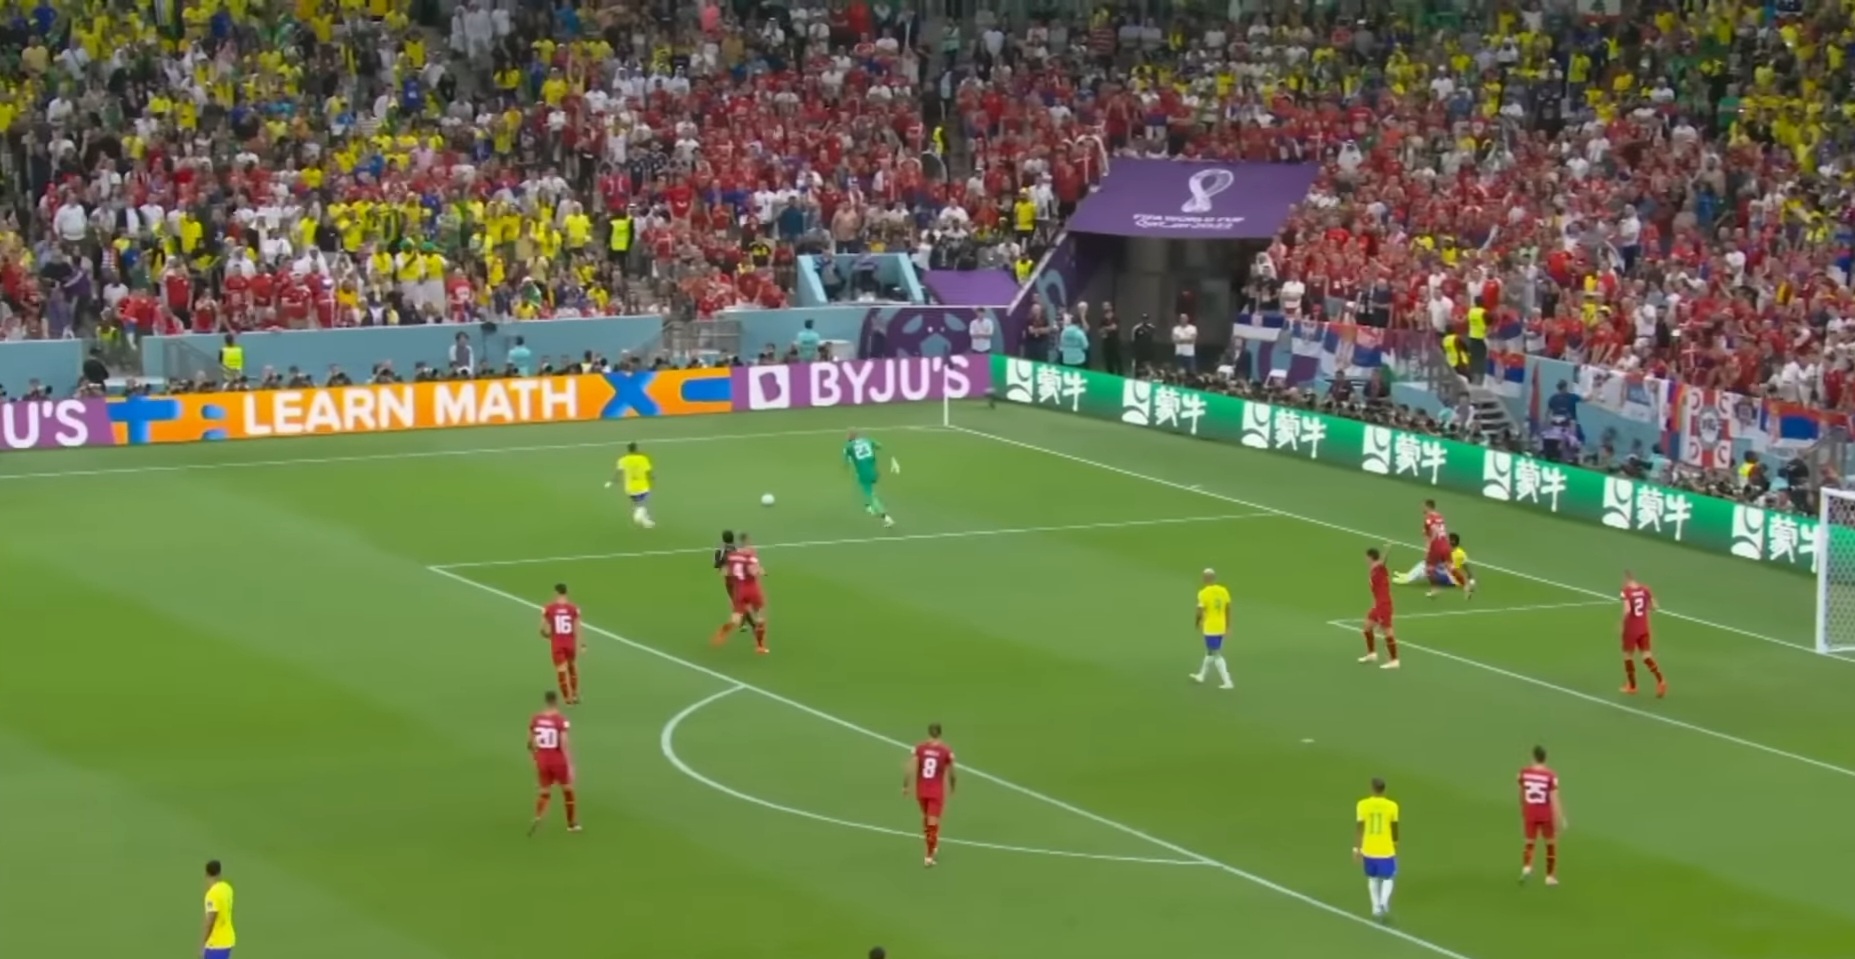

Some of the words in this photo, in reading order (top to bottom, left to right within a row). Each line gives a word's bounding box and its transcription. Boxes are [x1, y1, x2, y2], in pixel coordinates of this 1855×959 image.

[243, 383, 414, 437] LEARN
[434, 372, 577, 425] MATH
[809, 354, 970, 407] BYJU'S
[1037, 366, 1087, 412] 蒙牛
[3, 399, 88, 449] U'S
[1154, 387, 1207, 435] 蒙牛
[1274, 409, 1326, 459] 蒙牛
[1395, 433, 1447, 485] 蒙牛
[1515, 458, 1567, 512] 蒙牛
[1637, 485, 1692, 541] 蒙牛
[554, 615, 572, 634] 16
[1634, 597, 1644, 616] 2
[534, 727, 558, 748] 20
[922, 757, 937, 778] 8
[1524, 781, 1548, 804] 25
